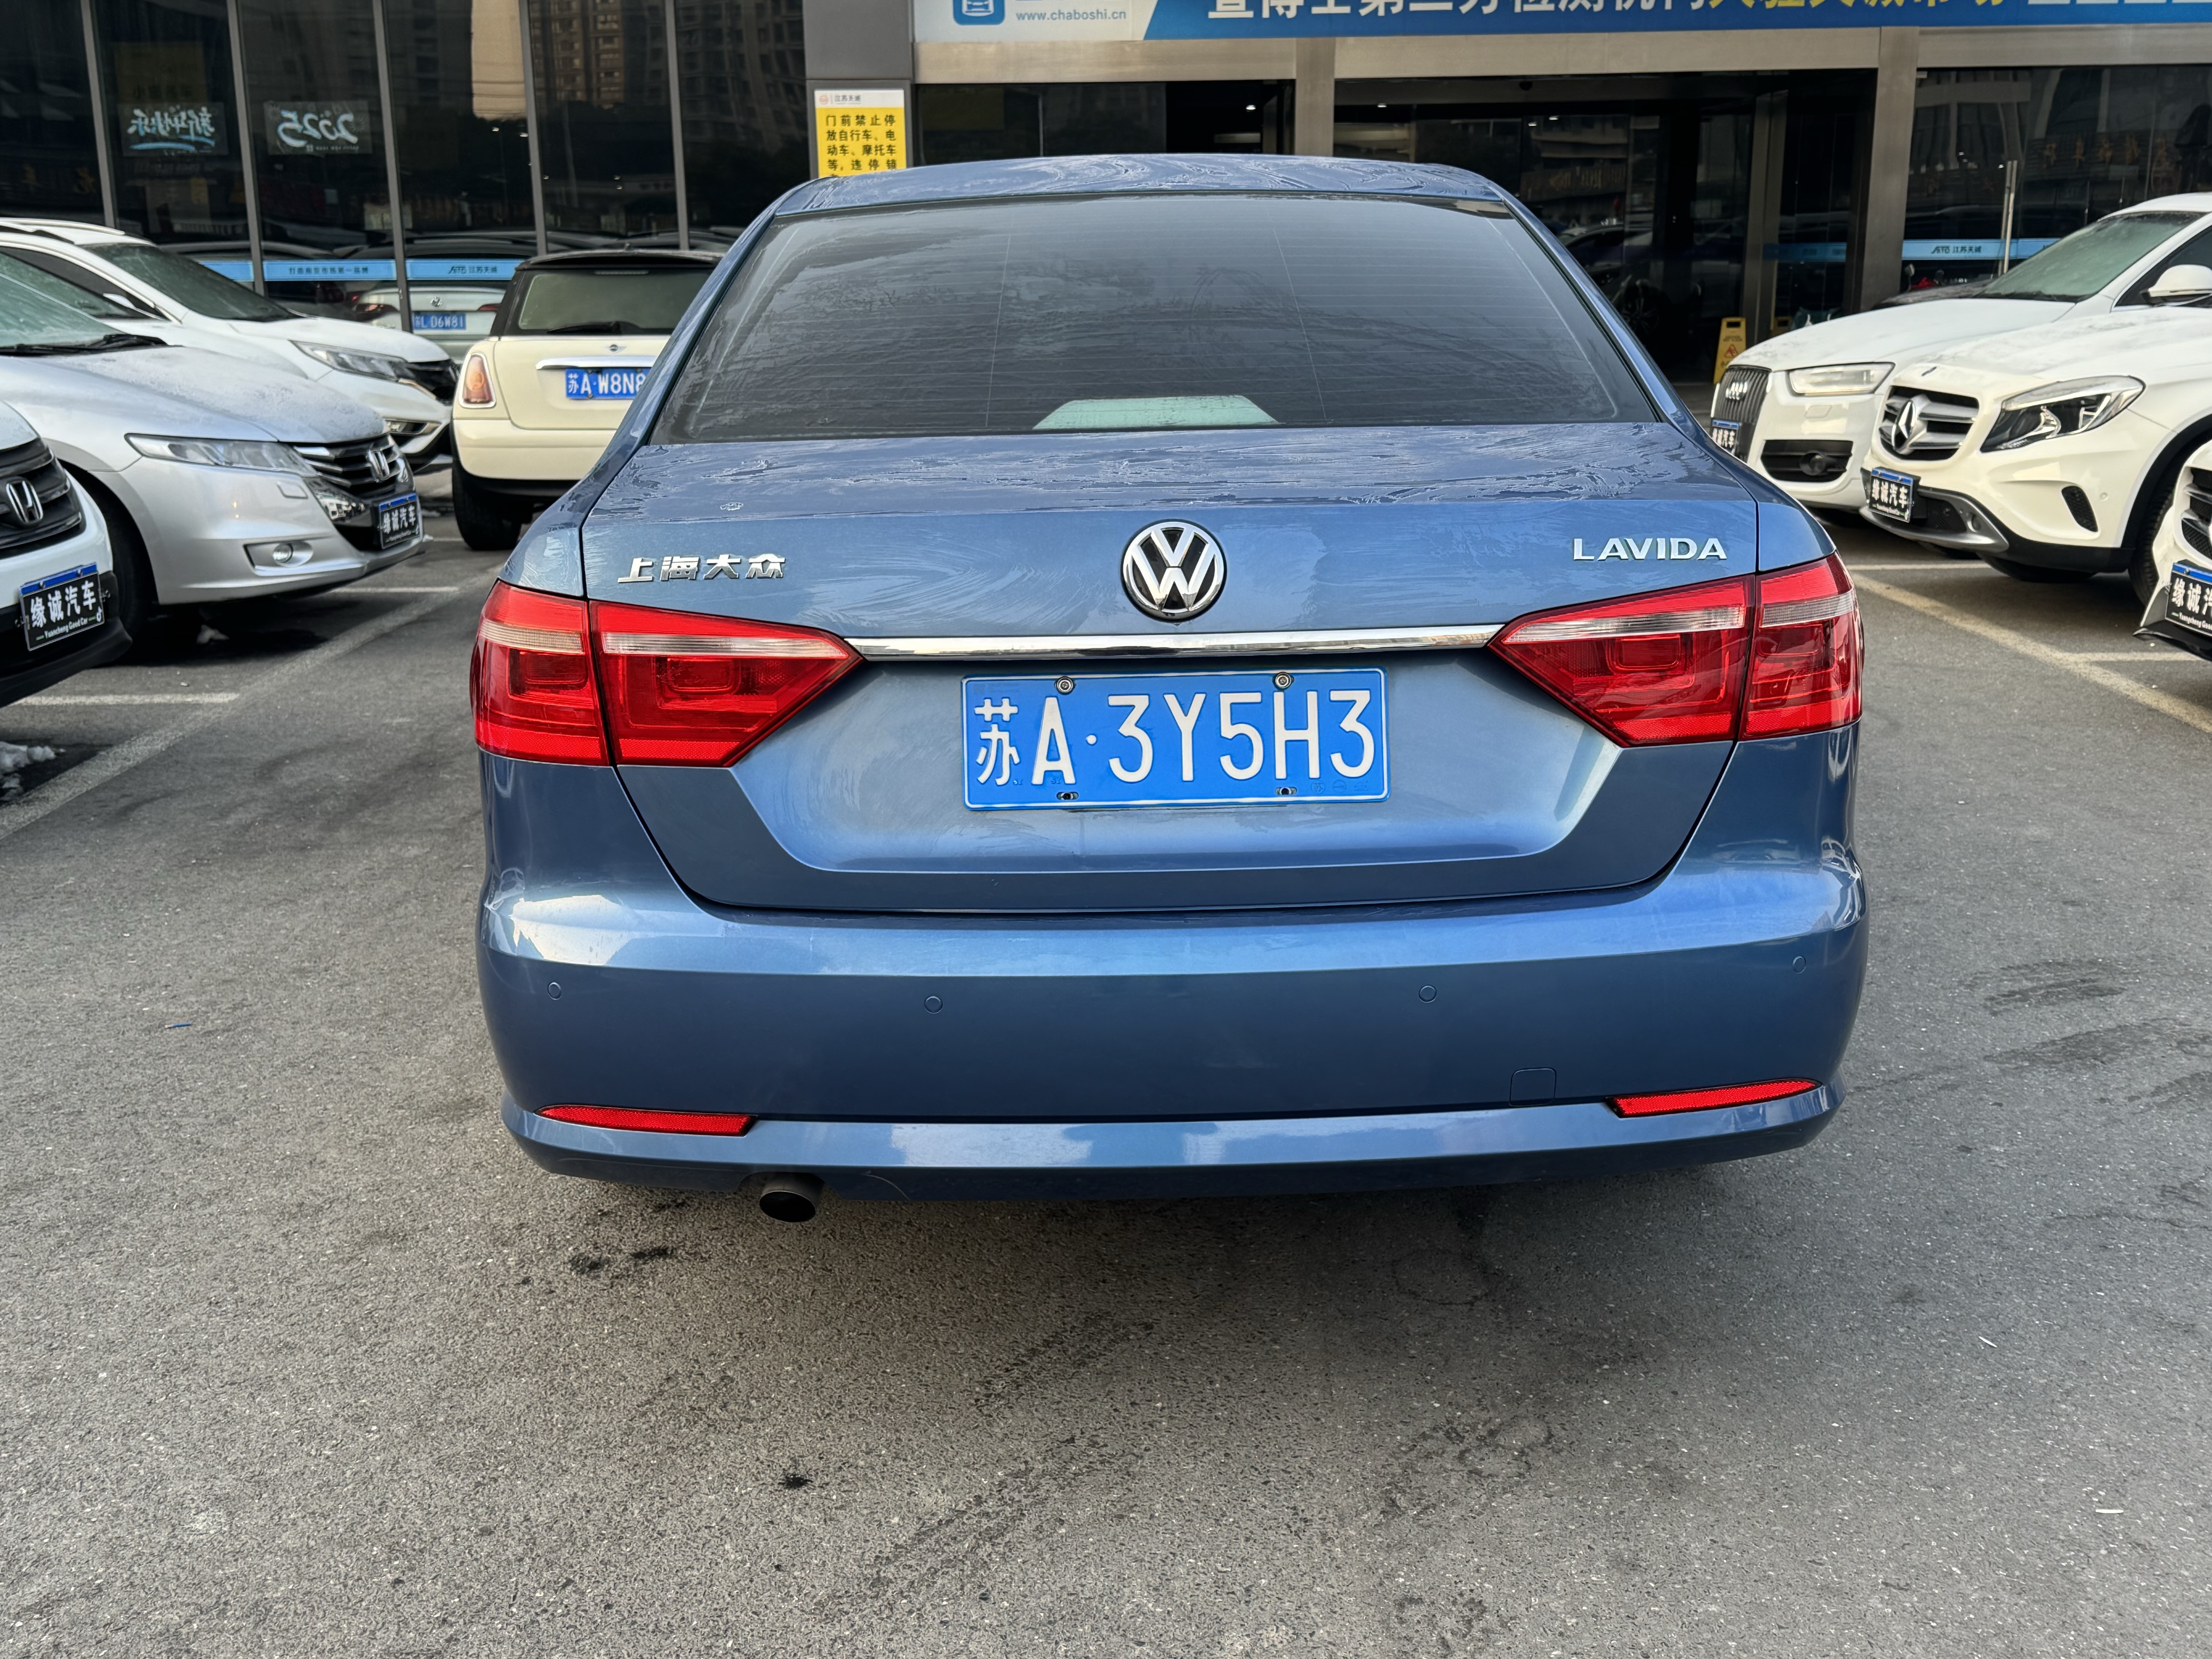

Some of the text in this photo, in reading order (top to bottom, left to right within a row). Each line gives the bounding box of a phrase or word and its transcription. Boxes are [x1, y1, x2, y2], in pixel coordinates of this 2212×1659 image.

[1016, 9, 1127, 21] www.chaboshi.cn
[825, 114, 896, 127] 门前禁止停
[826, 129, 896, 142] 放自行车、电
[827, 144, 897, 156] 动车、摩托车
[1573, 538, 1727, 561] LAVIDA
[617, 553, 786, 583] 上海大众
[31, 580, 96, 628] 缘诚汽车
